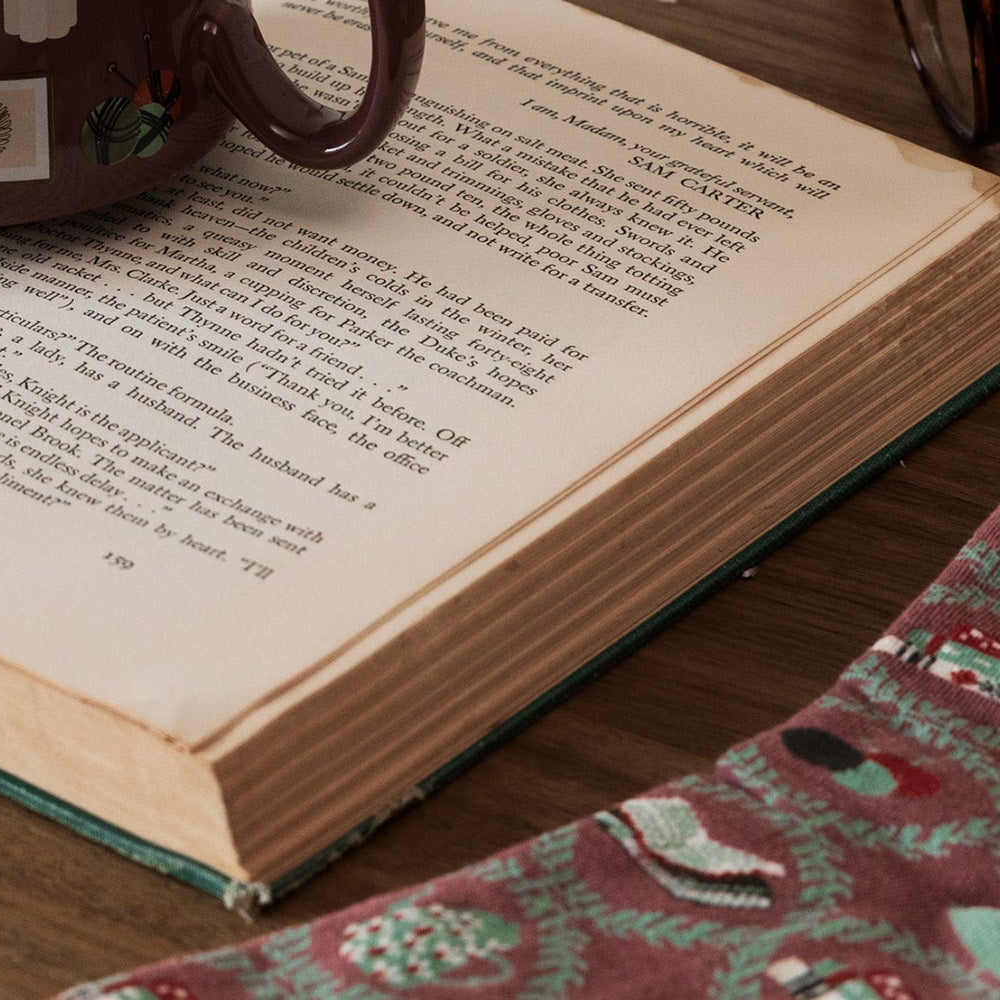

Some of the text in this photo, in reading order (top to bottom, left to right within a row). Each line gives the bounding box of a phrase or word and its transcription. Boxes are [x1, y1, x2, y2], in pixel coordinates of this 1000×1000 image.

[451, 26, 841, 191] me from everything that is horrible, it will be an
[519, 97, 794, 219] I am, Madam, your grateful servant,
[177, 172, 202, 186] to
[195, 179, 224, 193] see
[197, 164, 239, 182] what
[365, 153, 684, 297] two pound ten, the whole thing totting
[490, 125, 760, 243] on salt meat. She sent fifty pounds
[626, 155, 764, 220] SAM CARTER
[162, 182, 186, 197] at
[230, 205, 264, 220] did
[261, 216, 293, 231] not
[296, 227, 338, 246] want
[340, 243, 397, 274] money.
[402, 269, 432, 289] He
[434, 284, 472, 306] had
[472, 302, 513, 327] been
[513, 325, 560, 347] paid
[560, 344, 589, 361] for
[334, 177, 648, 318] settle down, and not write for a transfer.
[29, 271, 93, 299] manner,
[97, 293, 127, 310] the
[197, 339, 244, 363] smile
[317, 397, 354, 420] you,
[395, 430, 449, 461] better
[75, 339, 109, 362] The
[106, 358, 168, 391] routine
[166, 385, 233, 426] formula.
[126, 236, 514, 408] for Martha, a cupping for Parker the coachman.
[17, 376, 76, 410] Knight
[73, 403, 91, 417] is
[89, 411, 120, 431] the
[0, 388, 59, 423] Knight
[59, 417, 109, 447] hopes
[108, 443, 129, 458] to
[130, 455, 177, 481] make
[176, 479, 201, 493] an
[203, 490, 282, 525] exchange
[284, 522, 324, 544] with
[103, 552, 135, 570] 159
